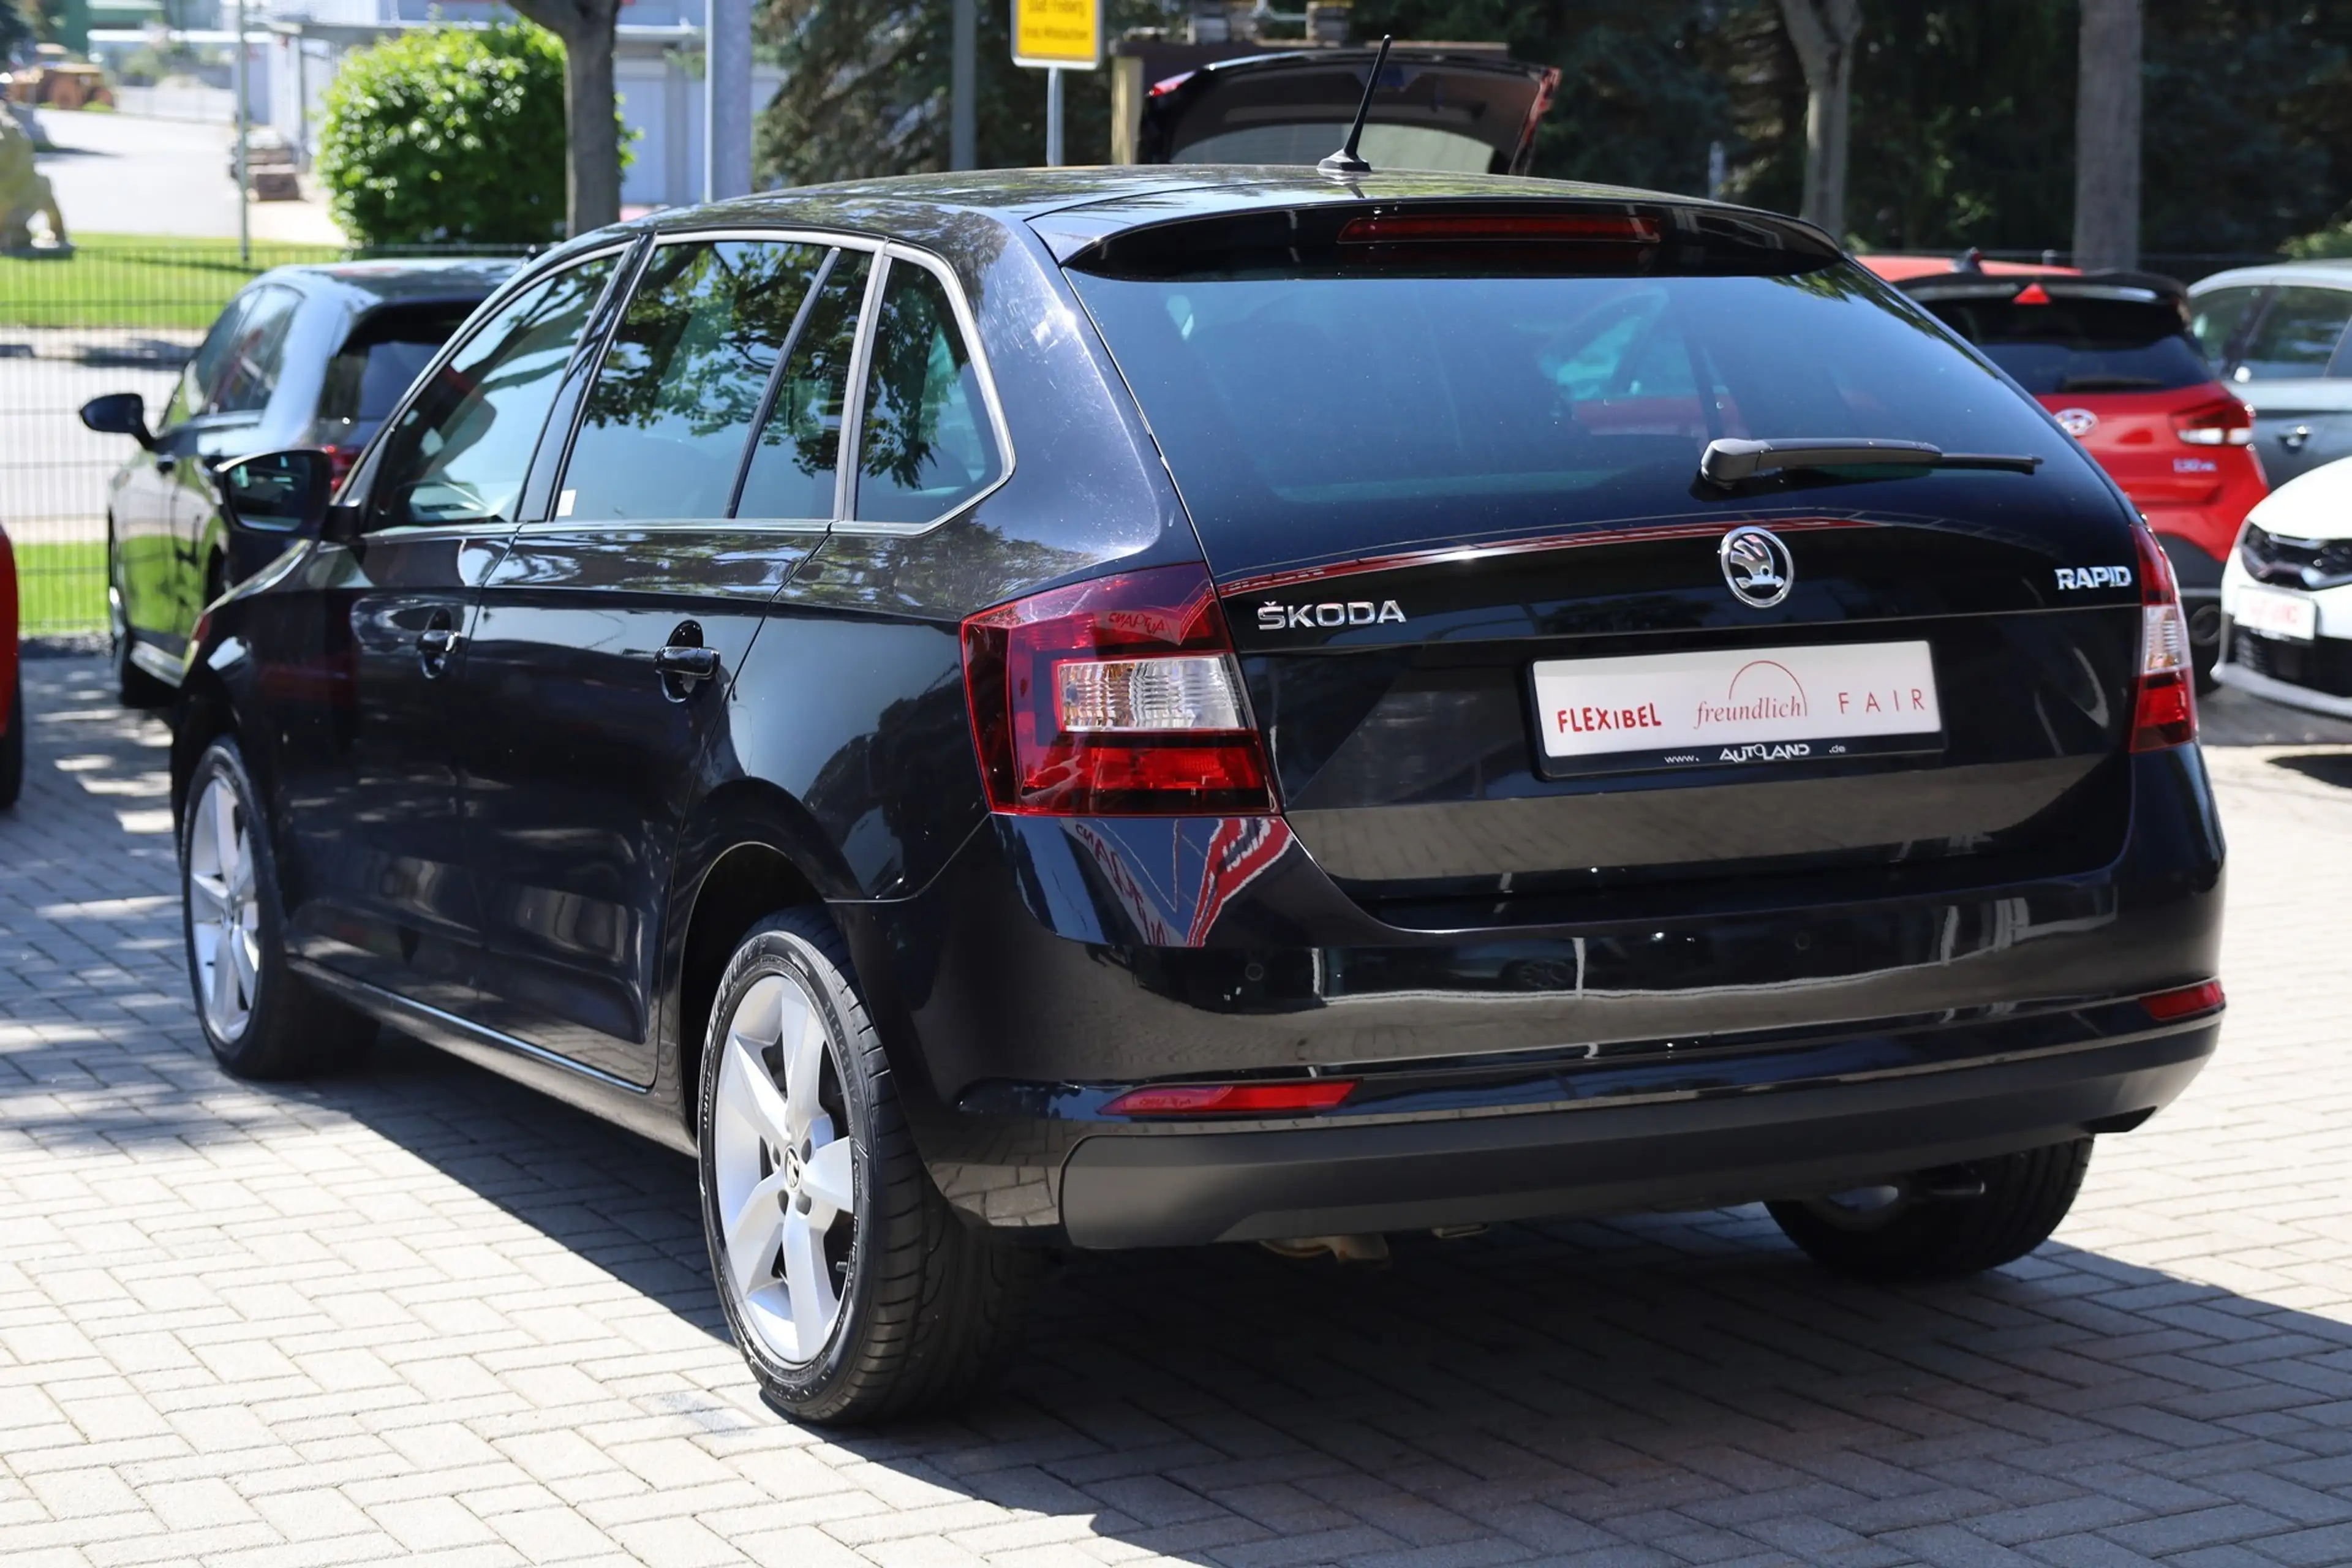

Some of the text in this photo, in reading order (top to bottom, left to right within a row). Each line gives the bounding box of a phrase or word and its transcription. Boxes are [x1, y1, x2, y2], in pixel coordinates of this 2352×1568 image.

[2054, 566, 2132, 590] RAPID
[1257, 600, 1407, 630] ŠKODA
[1557, 703, 1662, 733] FLEXIBEL
[1693, 695, 1801, 729] freundlich
[1664, 744, 1846, 764] www. AUTOLAND .de
